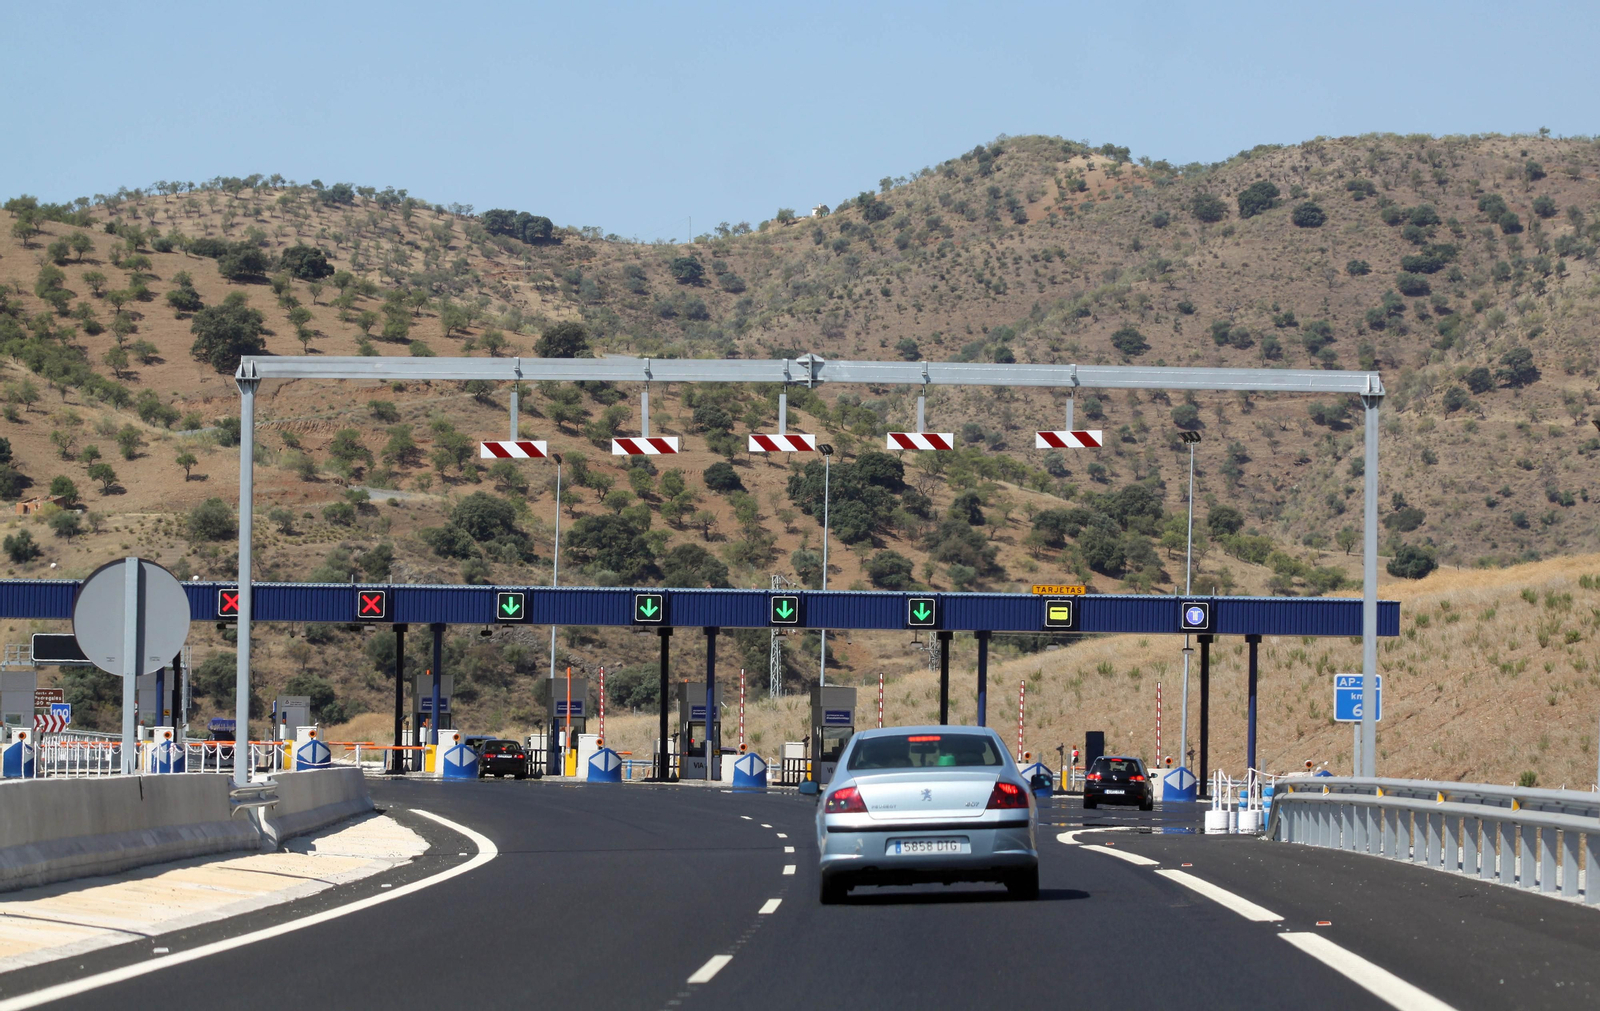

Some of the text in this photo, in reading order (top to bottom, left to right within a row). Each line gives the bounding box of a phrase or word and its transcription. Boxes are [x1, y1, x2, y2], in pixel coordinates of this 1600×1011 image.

[1036, 586, 1082, 594] TARJETAS
[1339, 677, 1378, 687] AP-
[53, 709, 69, 718] 100
[693, 761, 704, 769] VIA
[903, 840, 957, 852] 5858 DTG
